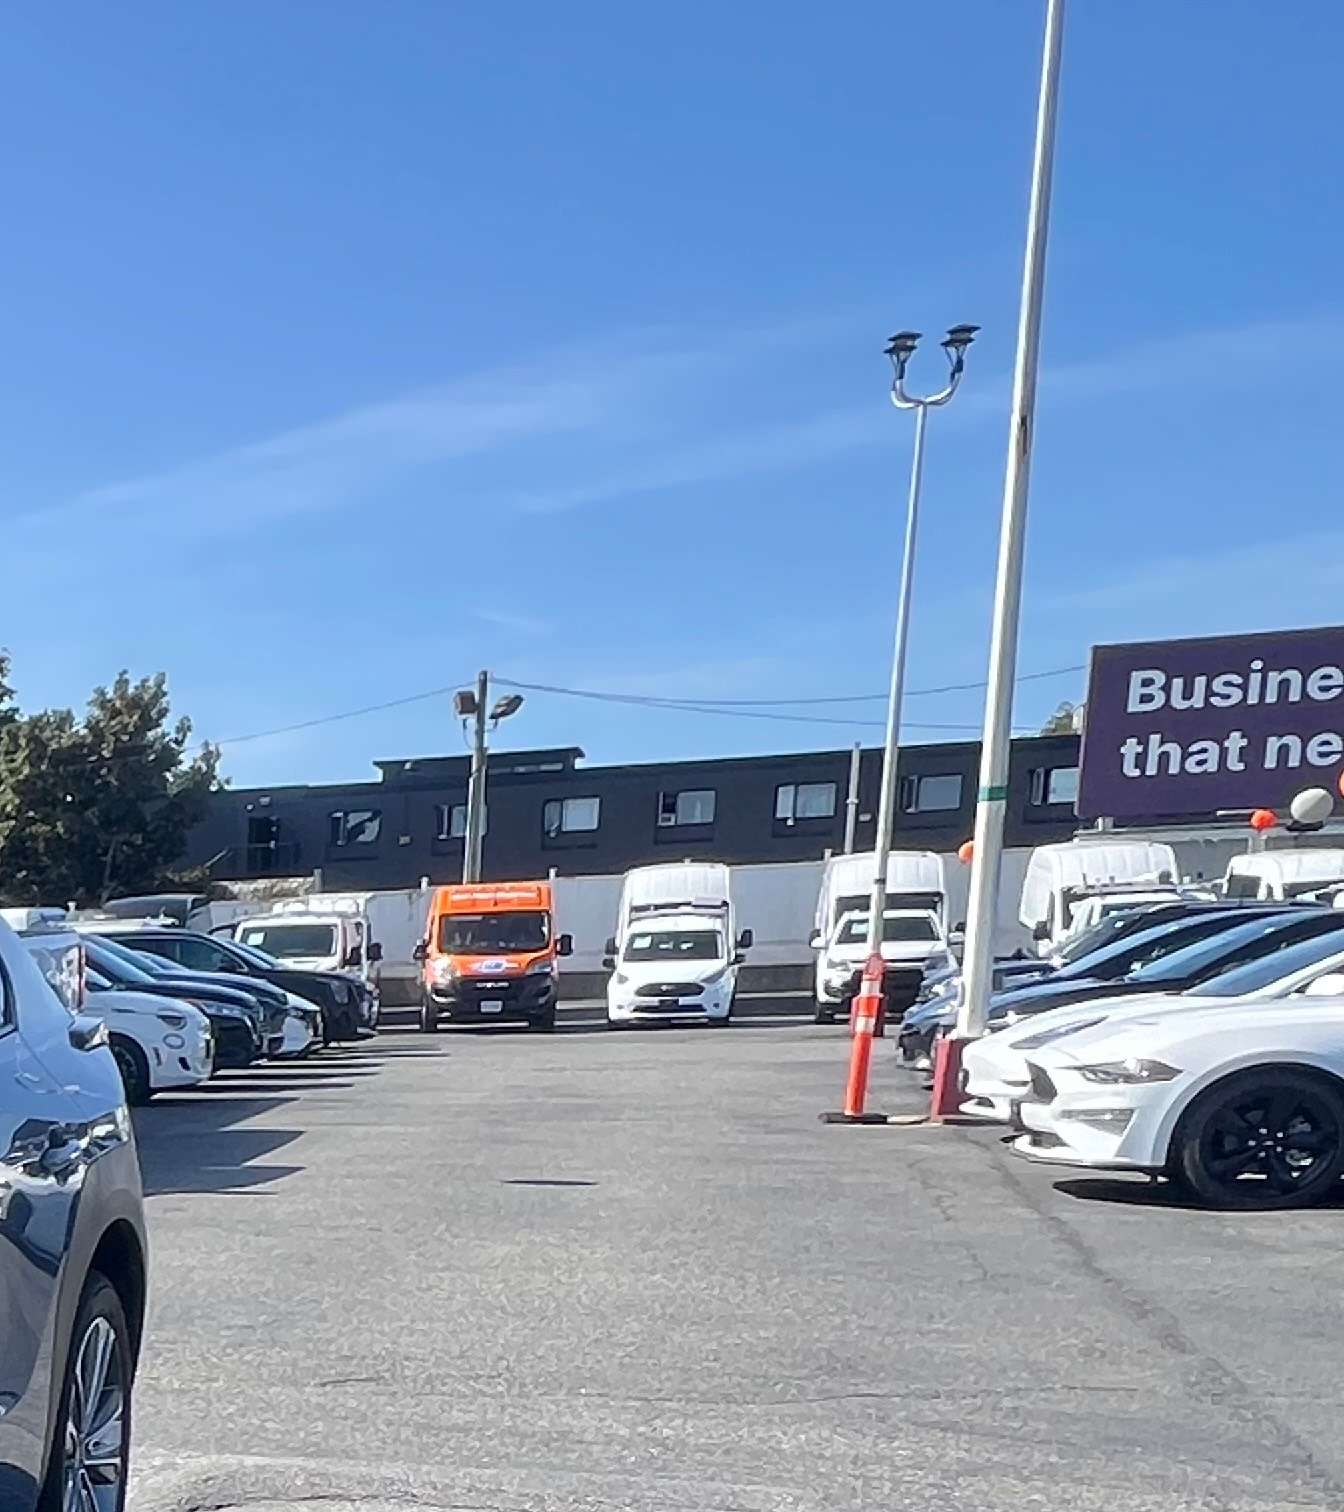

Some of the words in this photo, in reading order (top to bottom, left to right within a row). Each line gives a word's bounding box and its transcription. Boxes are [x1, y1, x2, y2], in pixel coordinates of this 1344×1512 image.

[1126, 659, 1344, 714] Busine
[1120, 731, 1249, 778] that
[1264, 731, 1344, 770] ne
